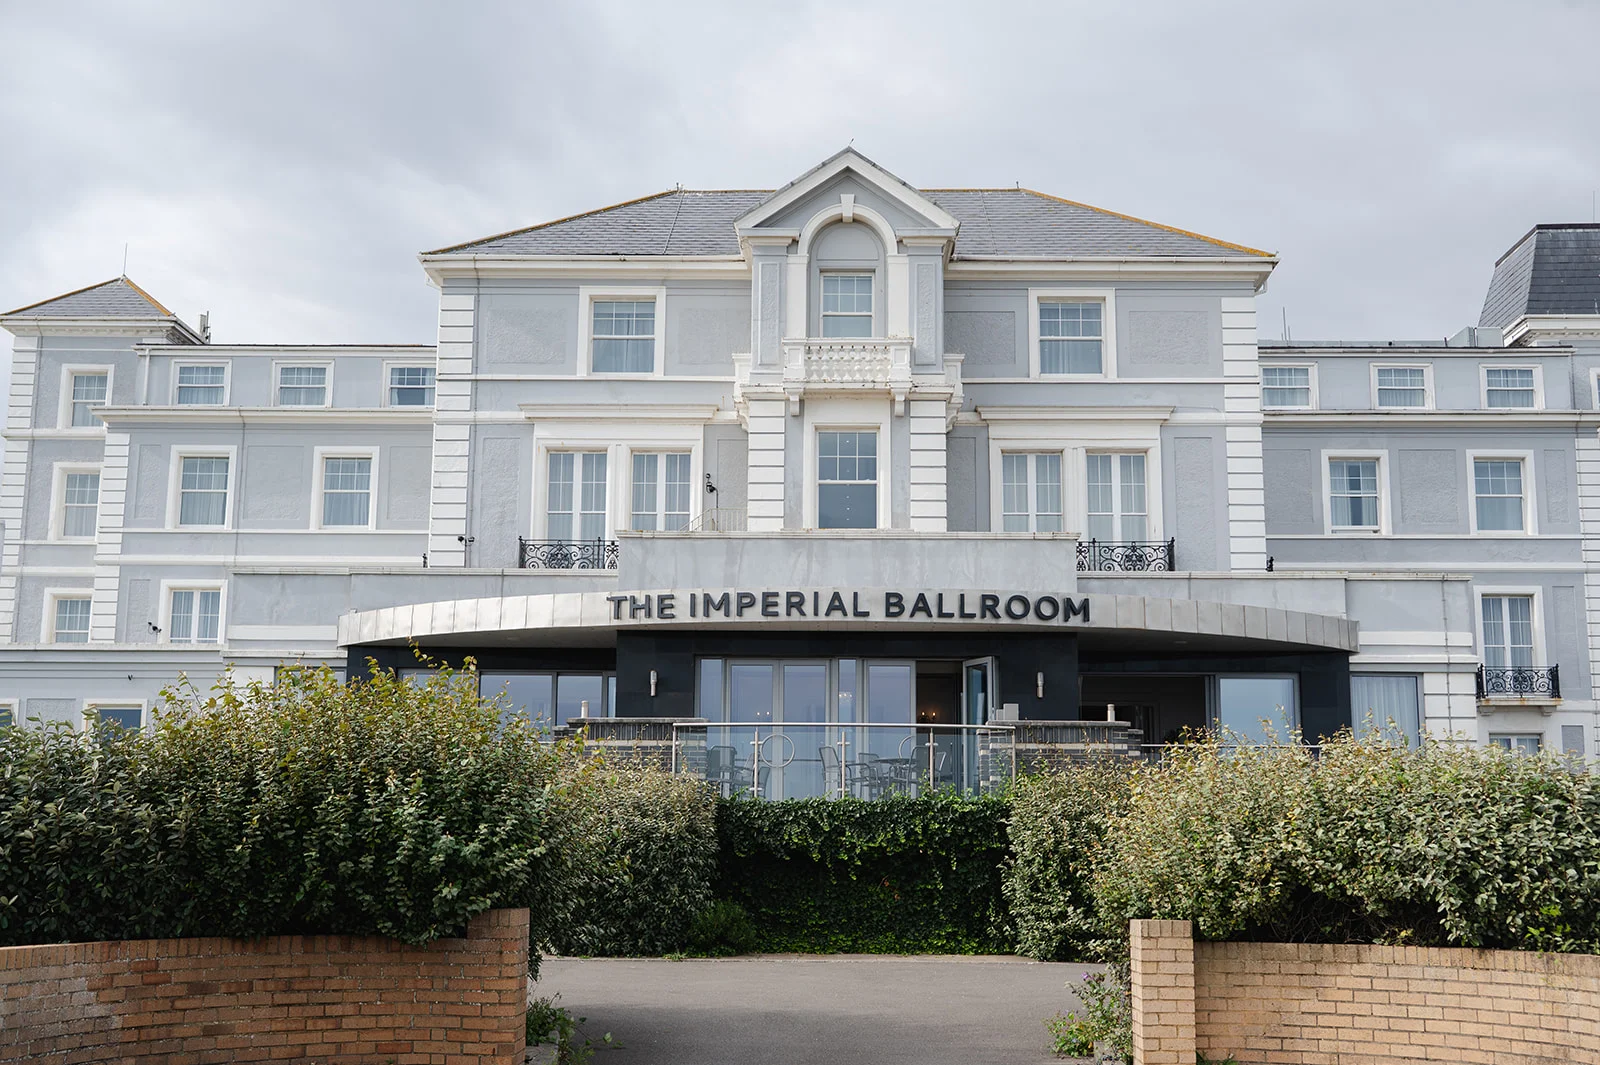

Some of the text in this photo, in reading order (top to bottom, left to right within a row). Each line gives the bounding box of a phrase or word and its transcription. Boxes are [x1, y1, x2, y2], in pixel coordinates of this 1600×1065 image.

[606, 591, 1091, 624] THE IMPERIAL BALLROOM
